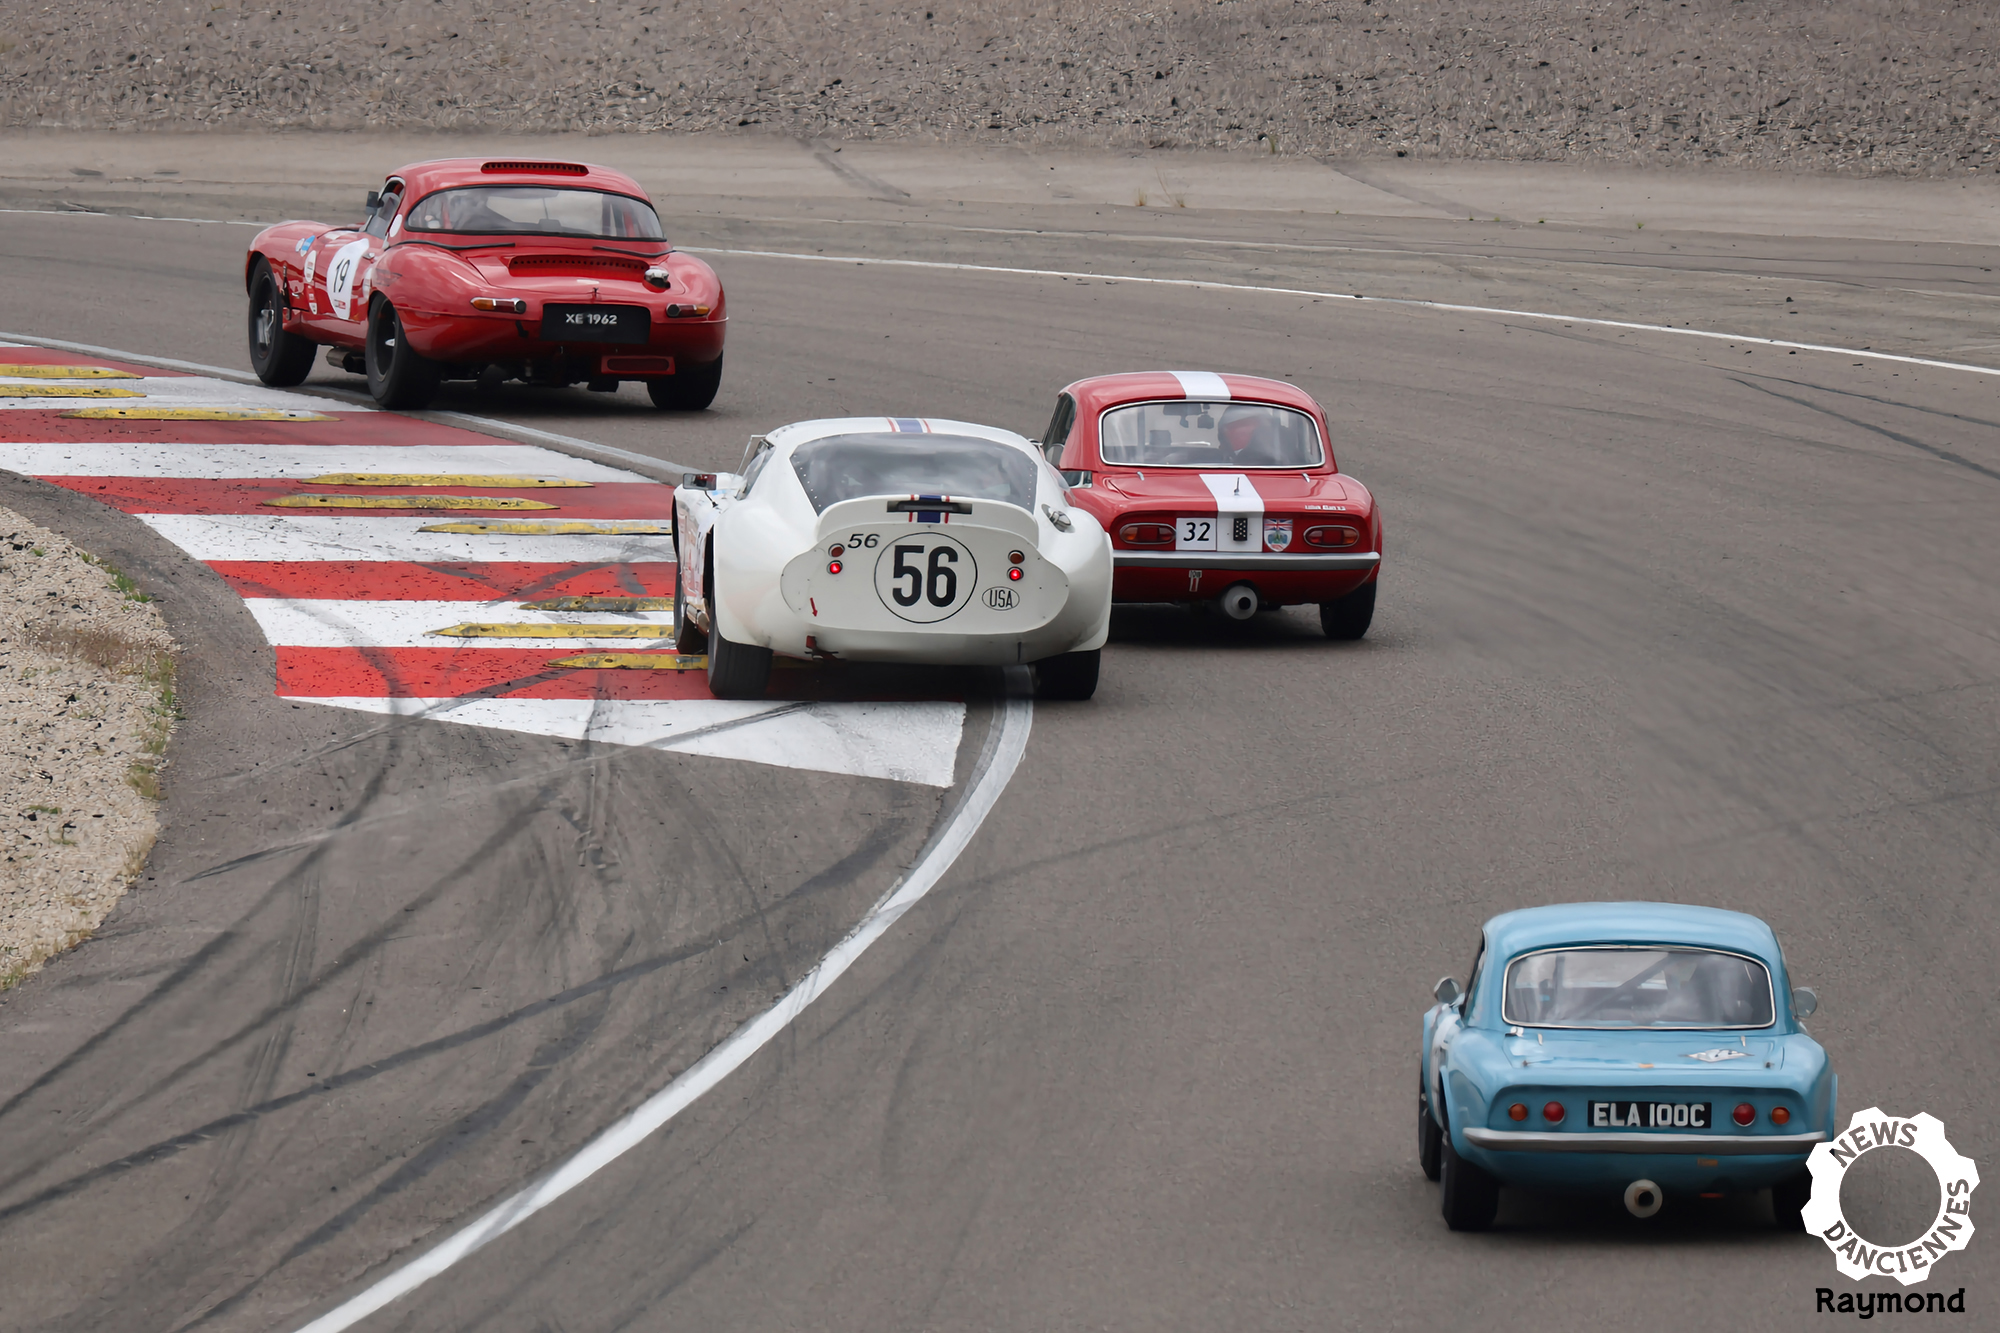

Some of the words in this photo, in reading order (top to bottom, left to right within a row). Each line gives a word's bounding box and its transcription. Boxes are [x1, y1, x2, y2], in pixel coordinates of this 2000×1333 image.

[333, 258, 351, 293] 19
[565, 313, 584, 325] XE
[587, 313, 618, 326] 1962
[847, 533, 880, 549] 56
[1183, 522, 1211, 542] 32
[892, 544, 959, 607] 56
[989, 589, 1014, 609] USA
[1593, 1102, 1640, 1128] ELA
[1648, 1103, 1706, 1128] 100C
